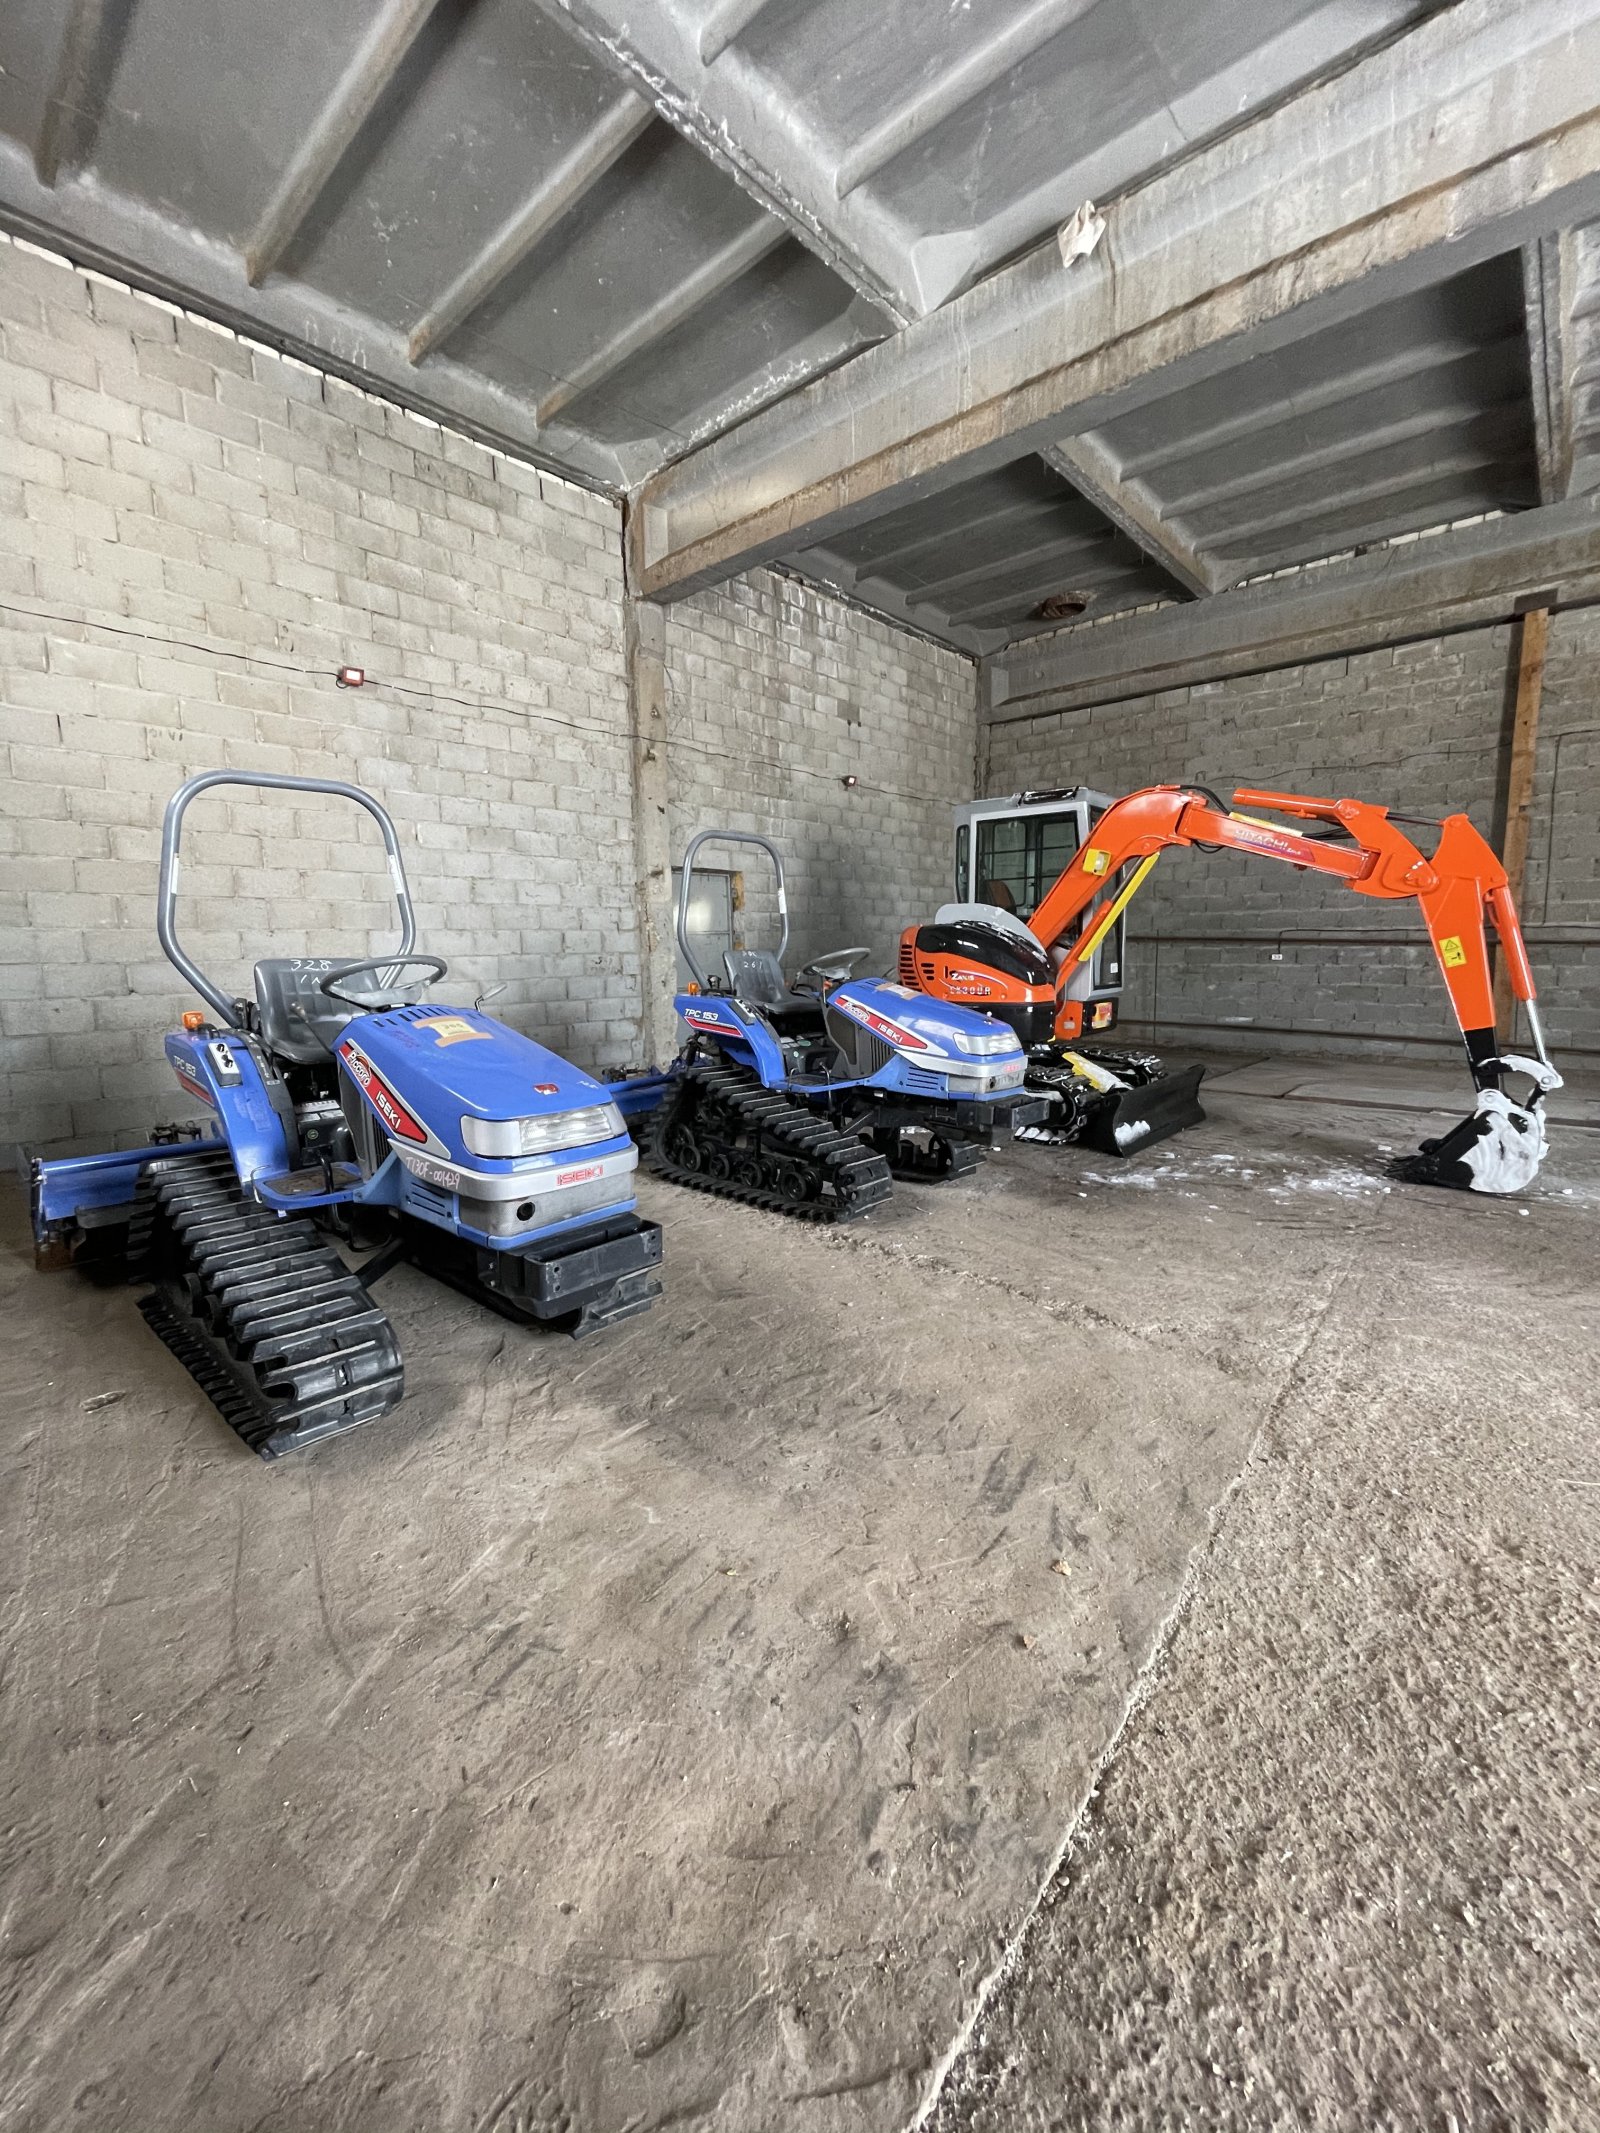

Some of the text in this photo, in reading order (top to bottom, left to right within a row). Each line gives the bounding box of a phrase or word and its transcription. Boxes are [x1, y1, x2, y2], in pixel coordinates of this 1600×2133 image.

[1234, 828, 1289, 851] HITACHI
[290, 959, 333, 971] 328
[684, 1008, 719, 1021] TPC 153
[877, 1022, 904, 1043] ISEKI
[375, 1090, 401, 1129] ISEKI
[556, 1164, 604, 1187] ISEKI
